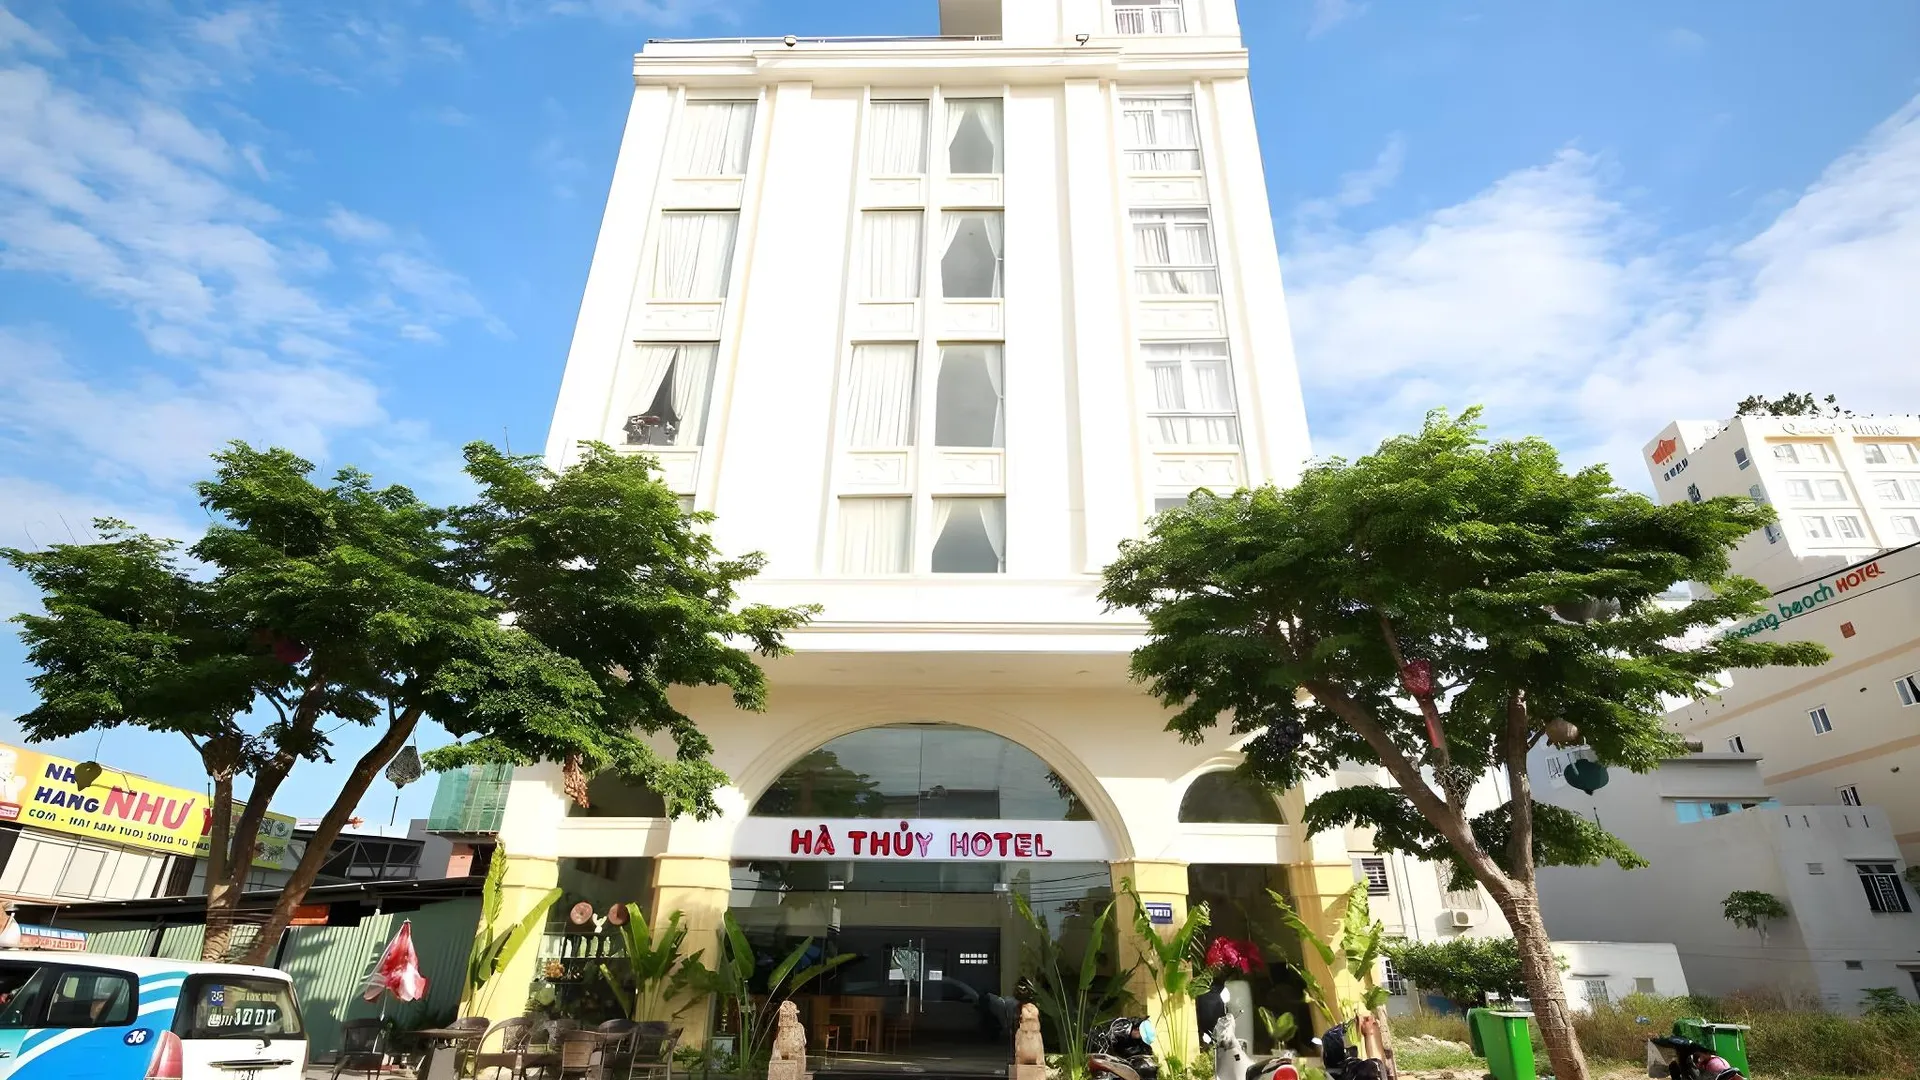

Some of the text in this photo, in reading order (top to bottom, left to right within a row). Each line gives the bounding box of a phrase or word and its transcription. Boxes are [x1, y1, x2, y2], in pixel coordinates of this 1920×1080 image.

[1778, 583, 1835, 619] beach
[1835, 562, 1886, 593] HOTEL
[790, 824, 836, 855] HÀ
[950, 832, 1053, 858] HOTEL
